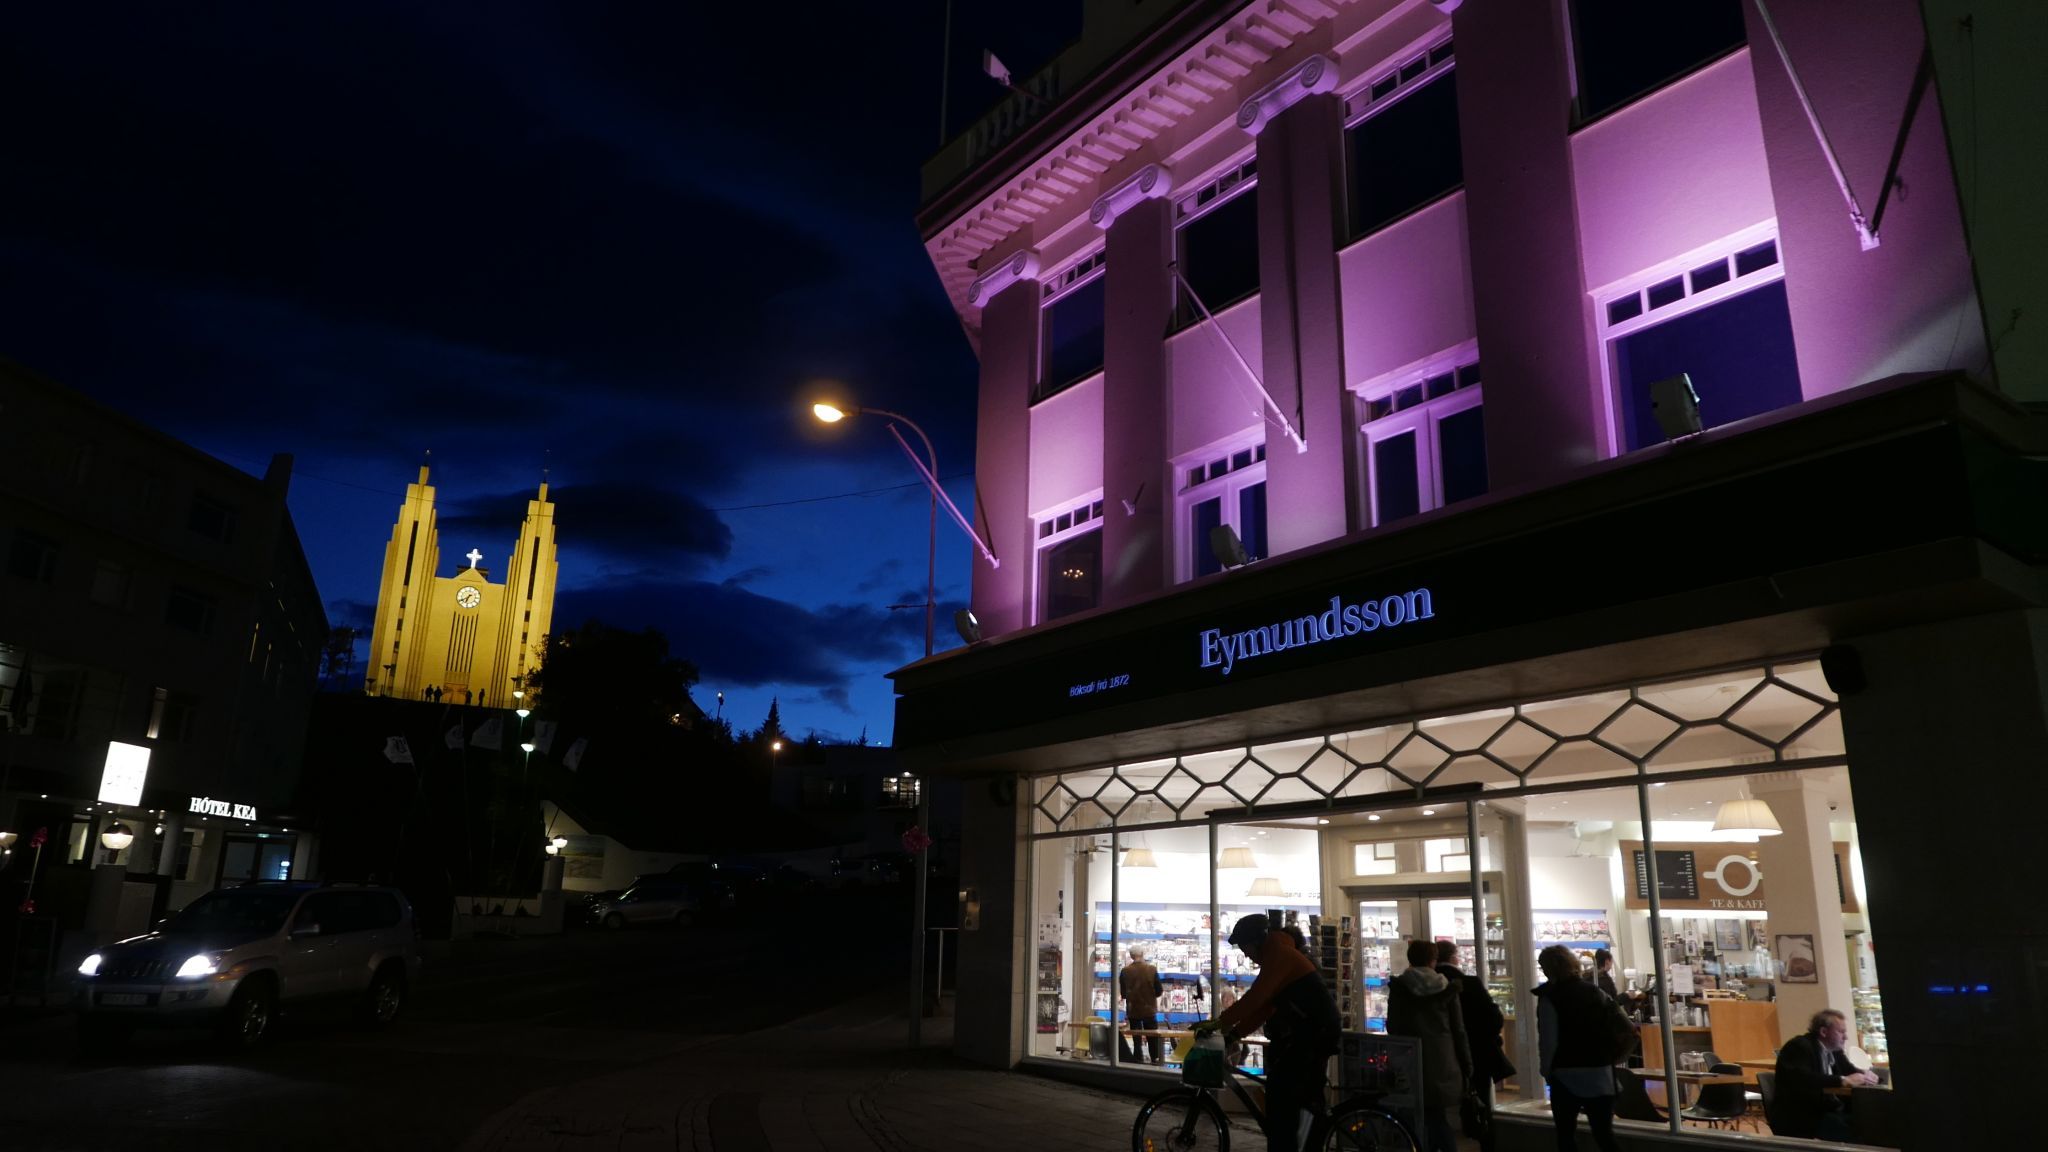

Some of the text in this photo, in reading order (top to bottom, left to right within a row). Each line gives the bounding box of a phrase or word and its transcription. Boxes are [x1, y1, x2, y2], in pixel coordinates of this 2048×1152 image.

[1200, 587, 1435, 675] Eymundsson
[1109, 674, 1130, 688] 1872
[189, 797, 256, 820] HÓTEL KEA
[1710, 898, 1725, 908] TE
[1727, 899, 1735, 909] &
